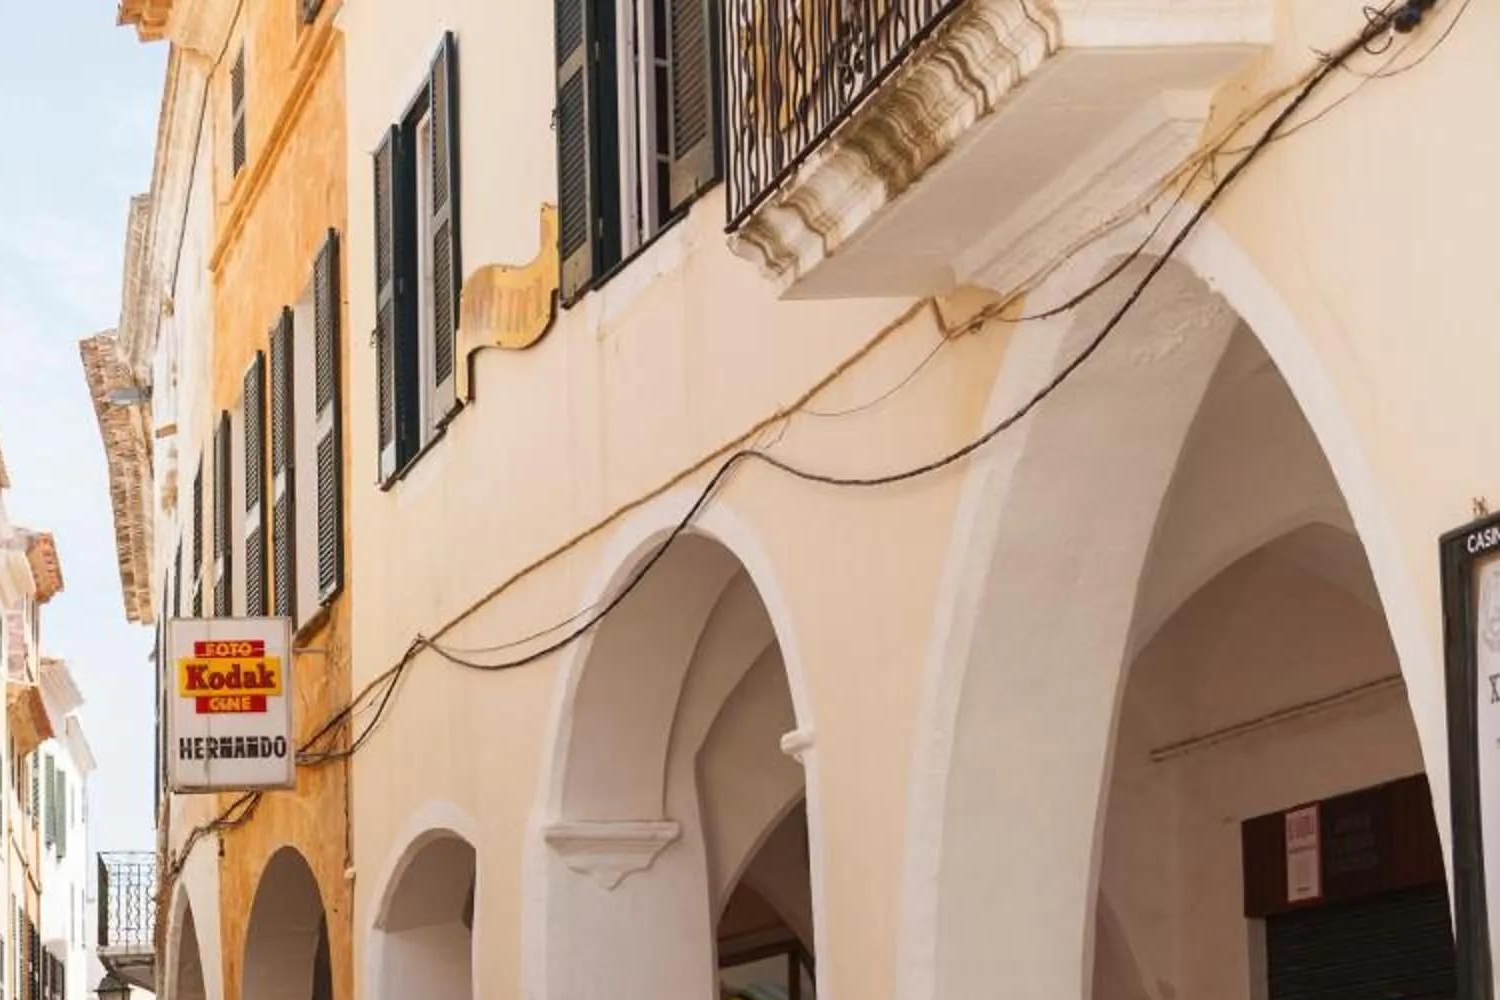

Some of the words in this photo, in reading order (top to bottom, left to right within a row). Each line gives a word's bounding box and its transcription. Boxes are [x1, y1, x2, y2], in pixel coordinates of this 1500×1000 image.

[204, 643, 252, 656] FOTO
[185, 664, 276, 690] Kodak
[208, 697, 252, 711] CINE
[179, 736, 287, 760] HERNANDO
